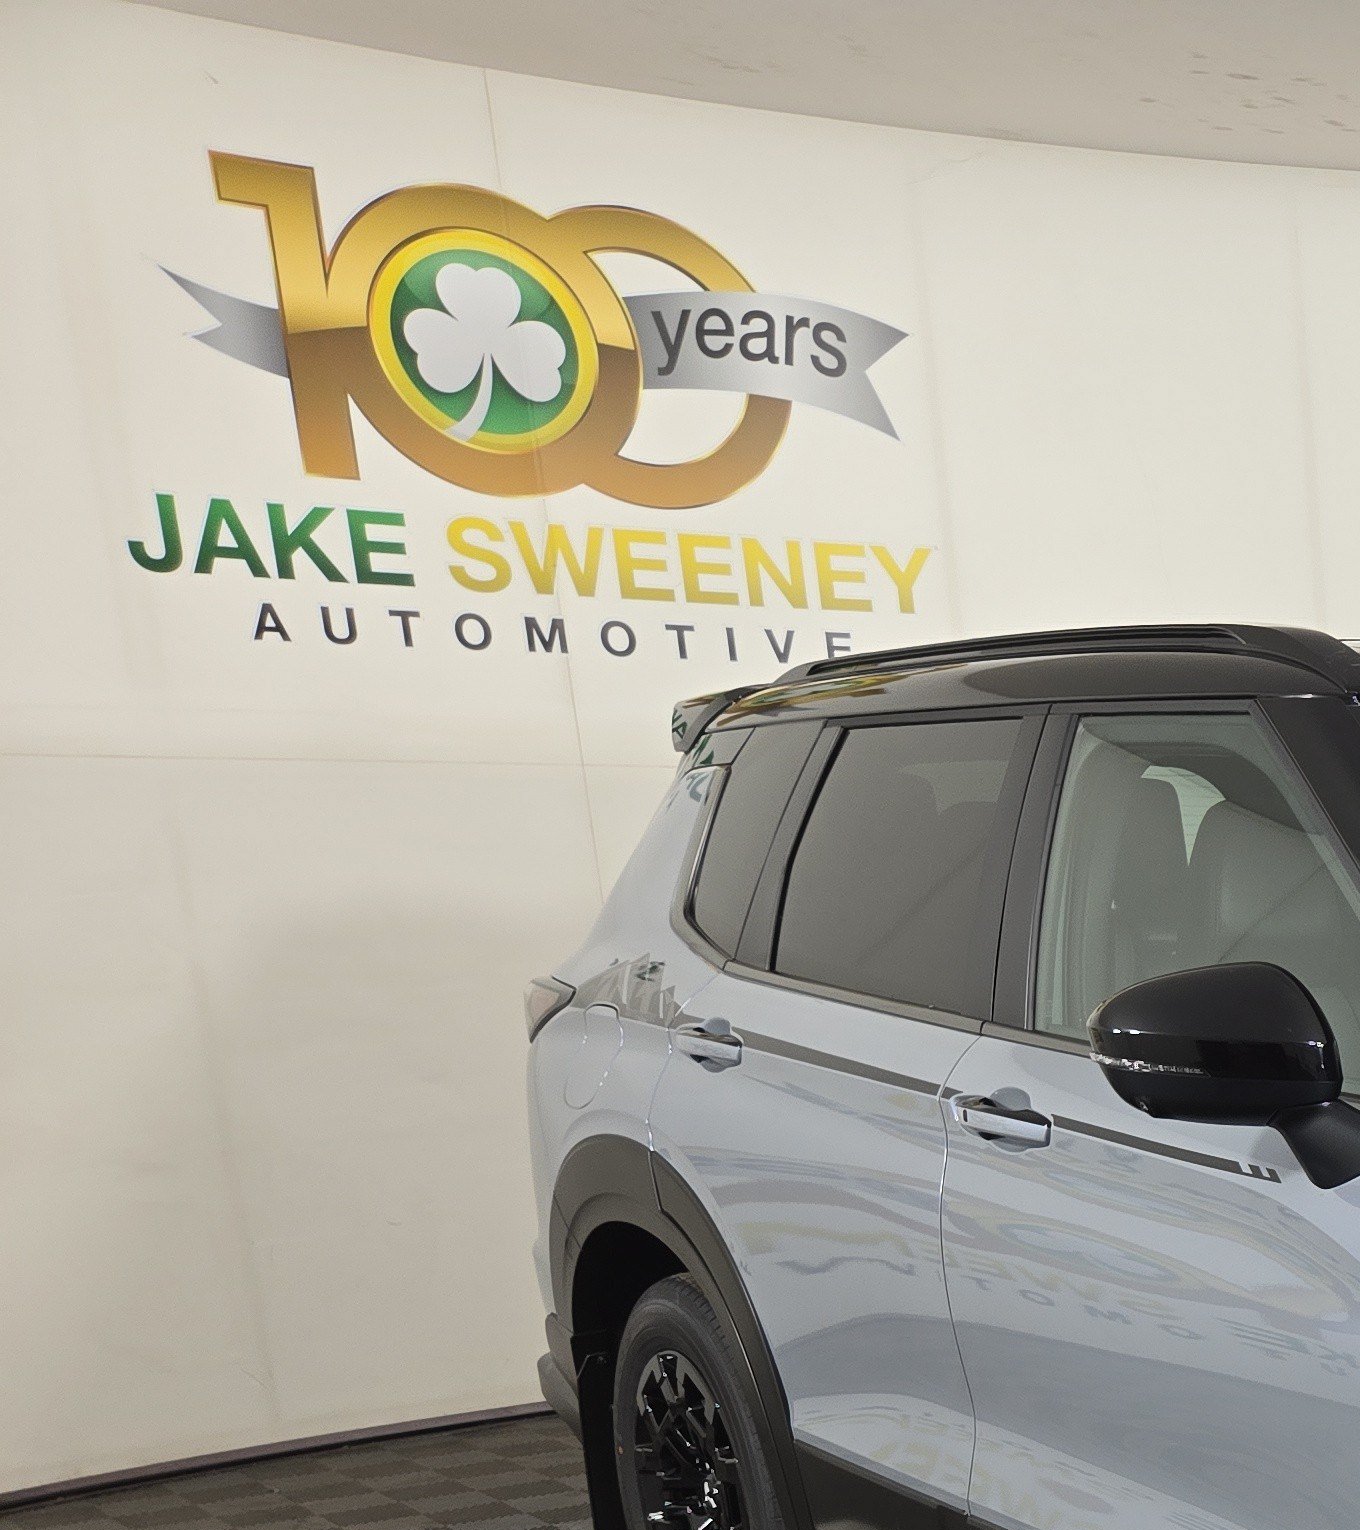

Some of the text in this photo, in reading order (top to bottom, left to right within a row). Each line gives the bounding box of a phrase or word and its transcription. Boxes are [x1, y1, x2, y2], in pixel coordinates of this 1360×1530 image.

[207, 149, 848, 510] 100 years
[126, 492, 933, 615] JAKE SWEENEY
[252, 602, 853, 665] AUTOMOTIVE
